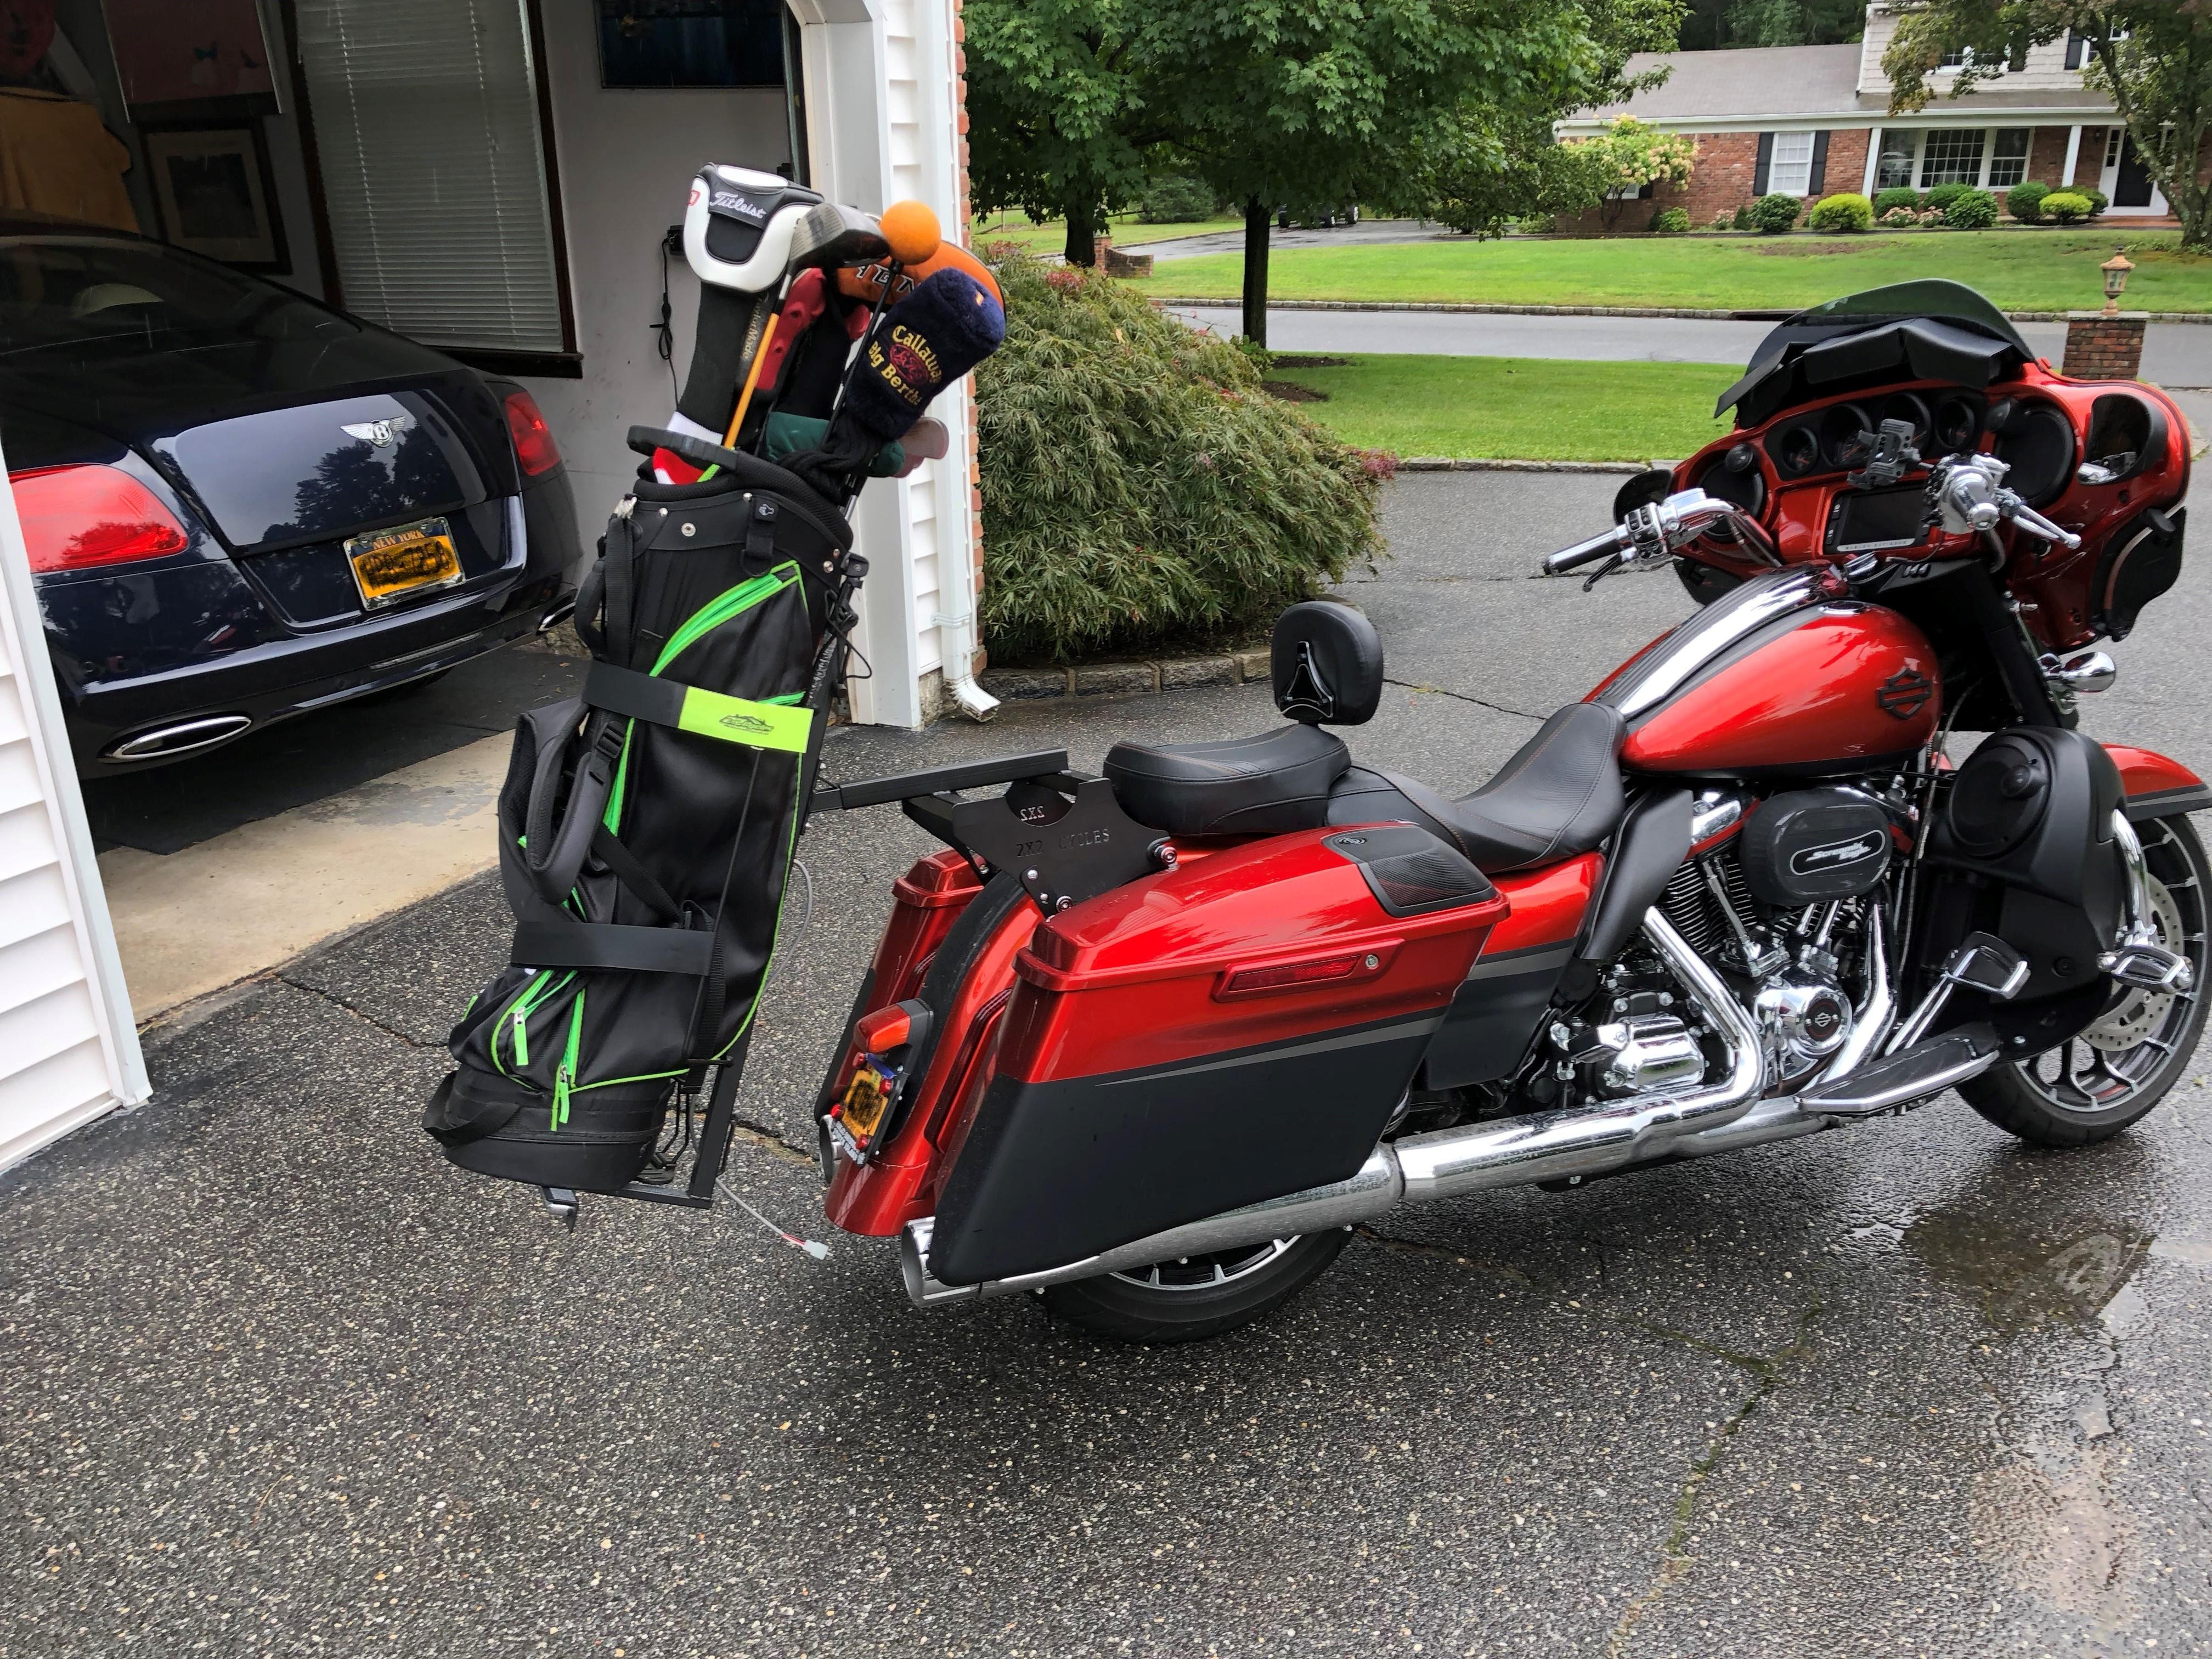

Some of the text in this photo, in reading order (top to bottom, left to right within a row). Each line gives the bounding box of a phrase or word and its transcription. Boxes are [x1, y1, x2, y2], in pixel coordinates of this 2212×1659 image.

[710, 191, 767, 219] Titleist
[869, 341, 885, 368] Big
[373, 535, 396, 550] NEW
[1016, 828, 1110, 857] 2X2 CYCLES
[1838, 847, 1872, 861] Eagle
